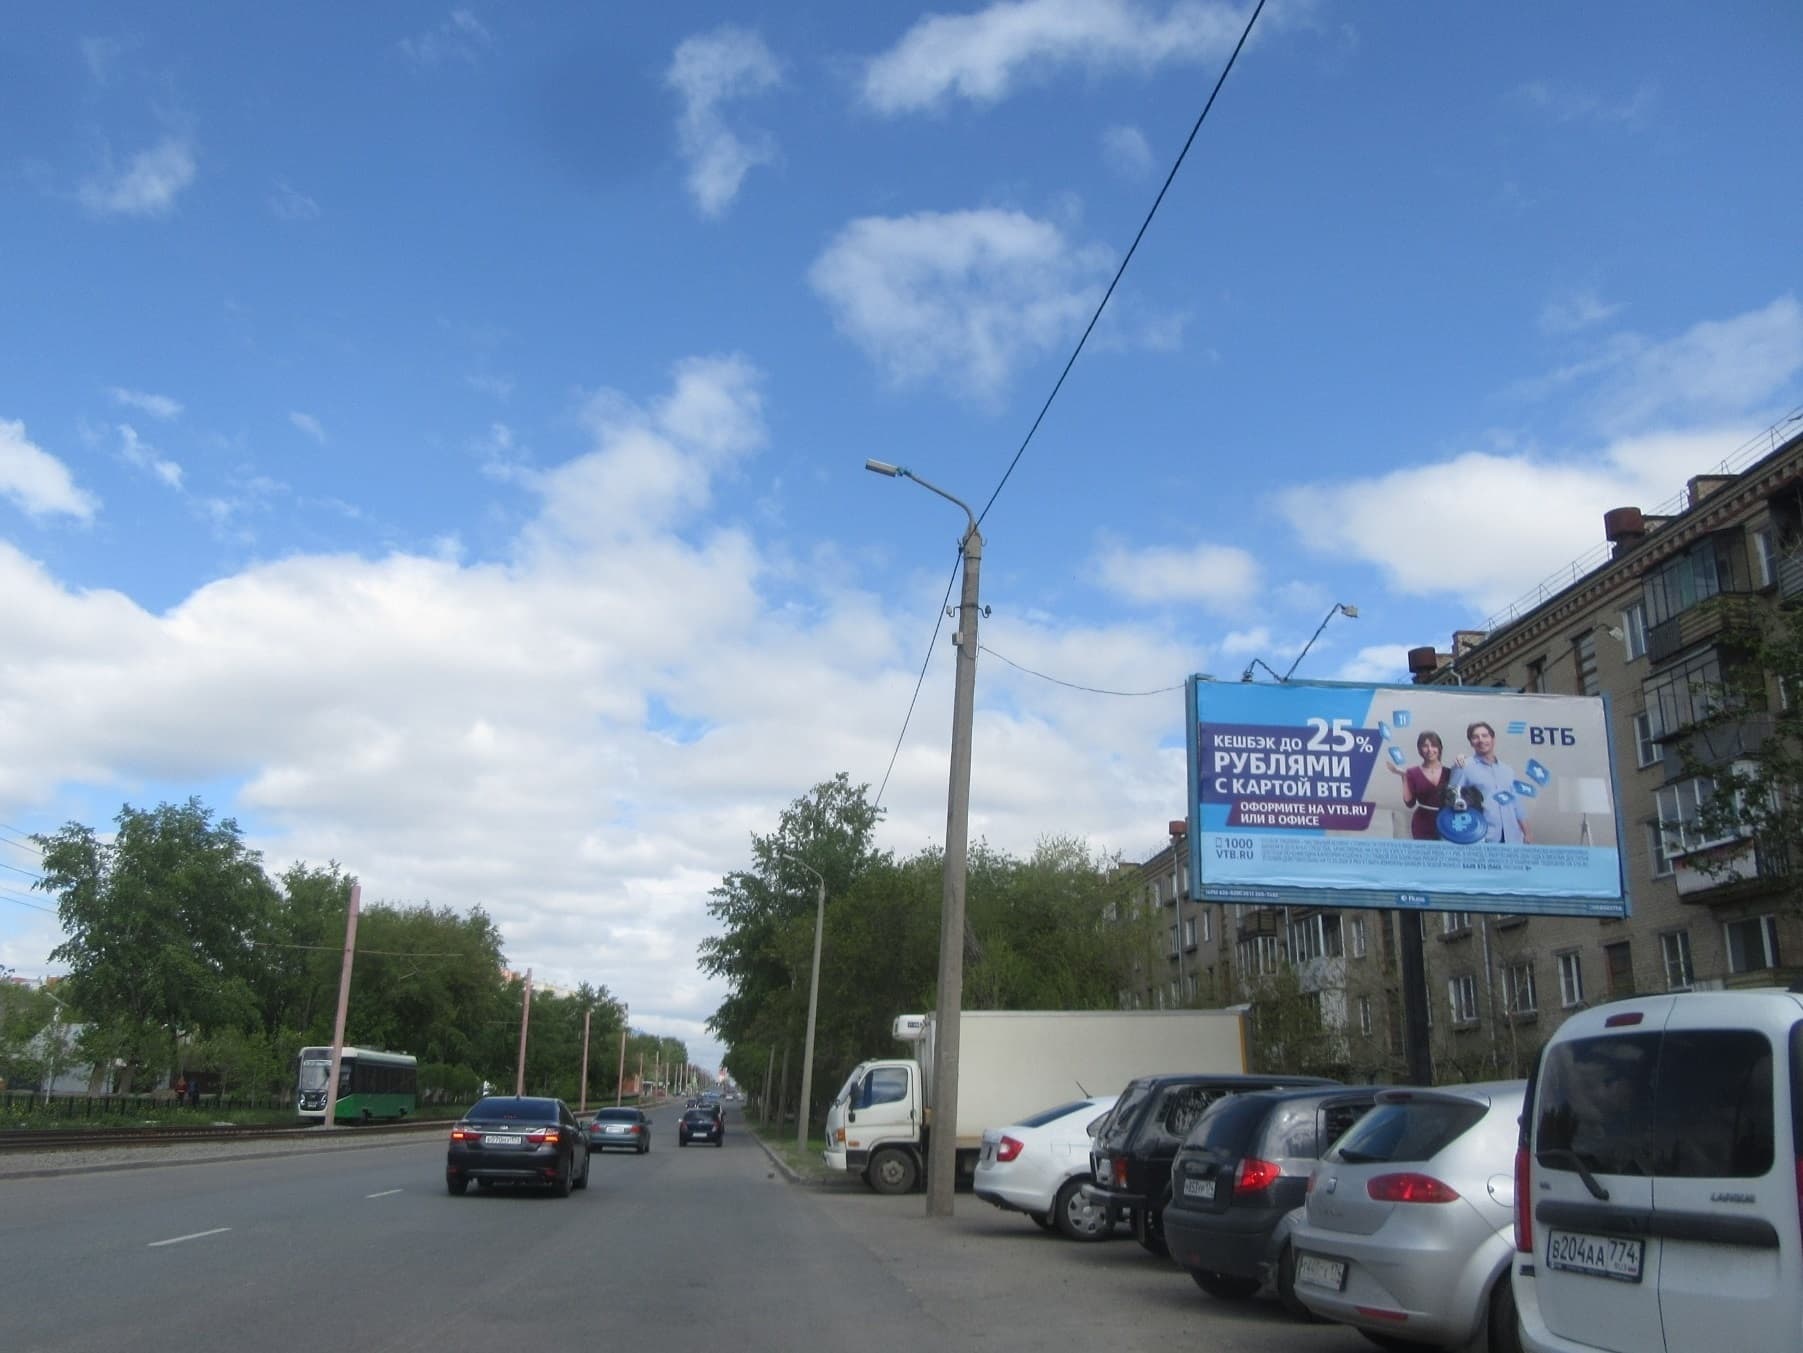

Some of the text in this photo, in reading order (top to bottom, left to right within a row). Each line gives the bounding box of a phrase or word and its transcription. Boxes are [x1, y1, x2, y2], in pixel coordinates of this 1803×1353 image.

[1213, 717, 1374, 753] КЕШБЭК ДО 25%
[1529, 725, 1577, 747] ВТБ
[1213, 752, 1351, 777] РУБЛЯМИ
[1215, 777, 1352, 798] С КАРТОЙ ВТБ
[1240, 801, 1368, 816] ОФОРМИТЕ НА VTB.RU
[1240, 814, 1320, 826] ИЛИ В ОФИСЕ
[1225, 838, 1253, 849] 1000
[1216, 849, 1254, 860] VTB.RU
